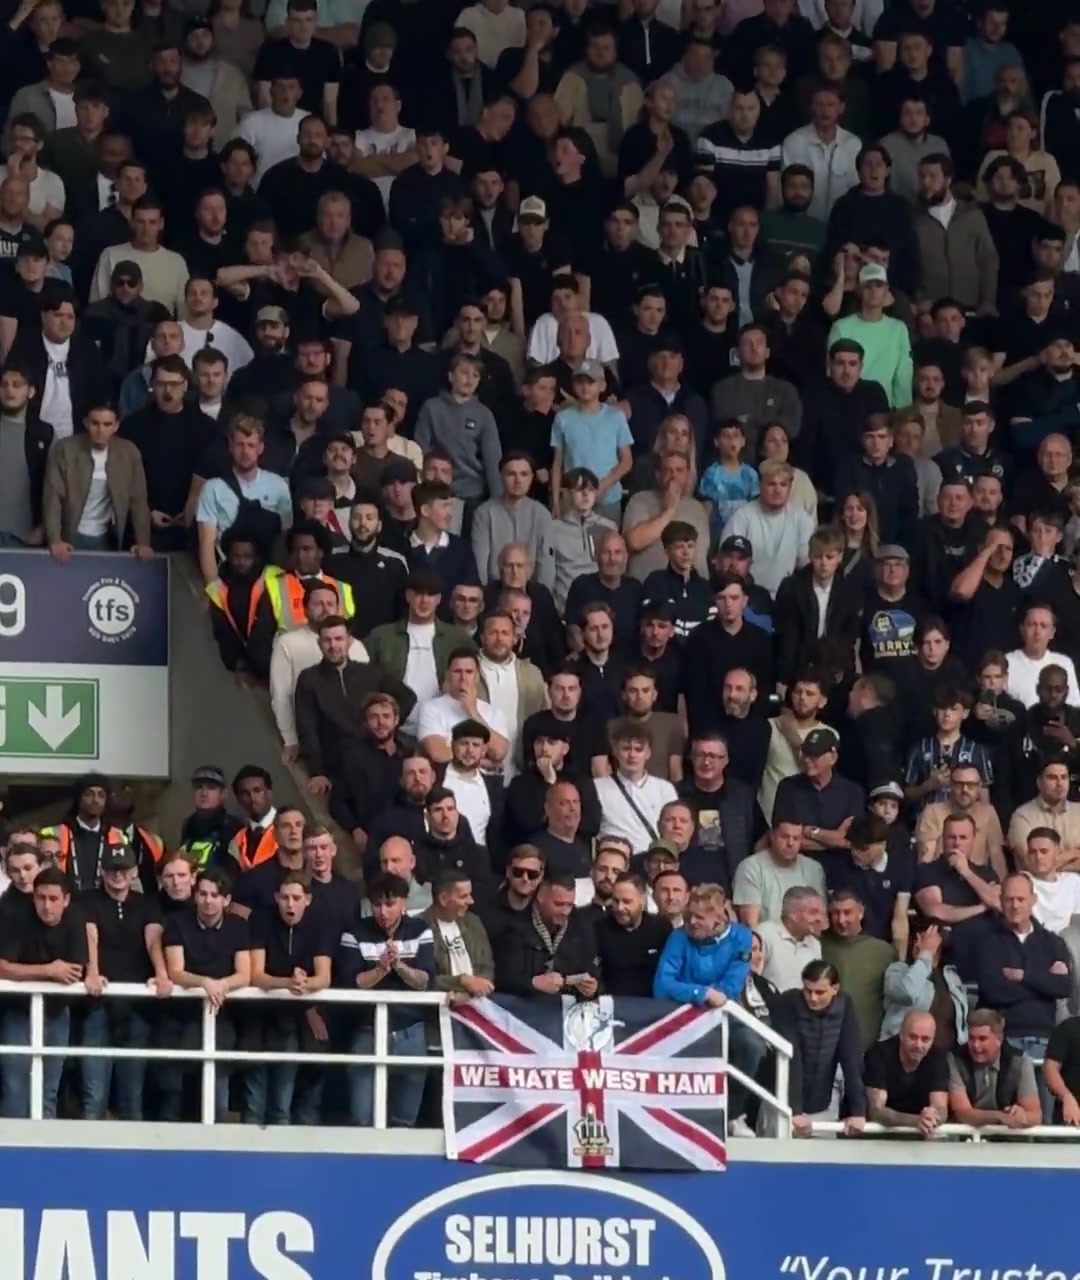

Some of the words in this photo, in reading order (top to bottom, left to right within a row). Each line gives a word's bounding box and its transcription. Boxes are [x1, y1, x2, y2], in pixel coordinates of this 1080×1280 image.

[94, 598, 130, 621] tfs
[460, 1066, 499, 1087] WE
[508, 1068, 574, 1090] HATE
[582, 1069, 650, 1090] WEST
[658, 1073, 716, 1094] HAM
[445, 1214, 656, 1266] SELHURST
